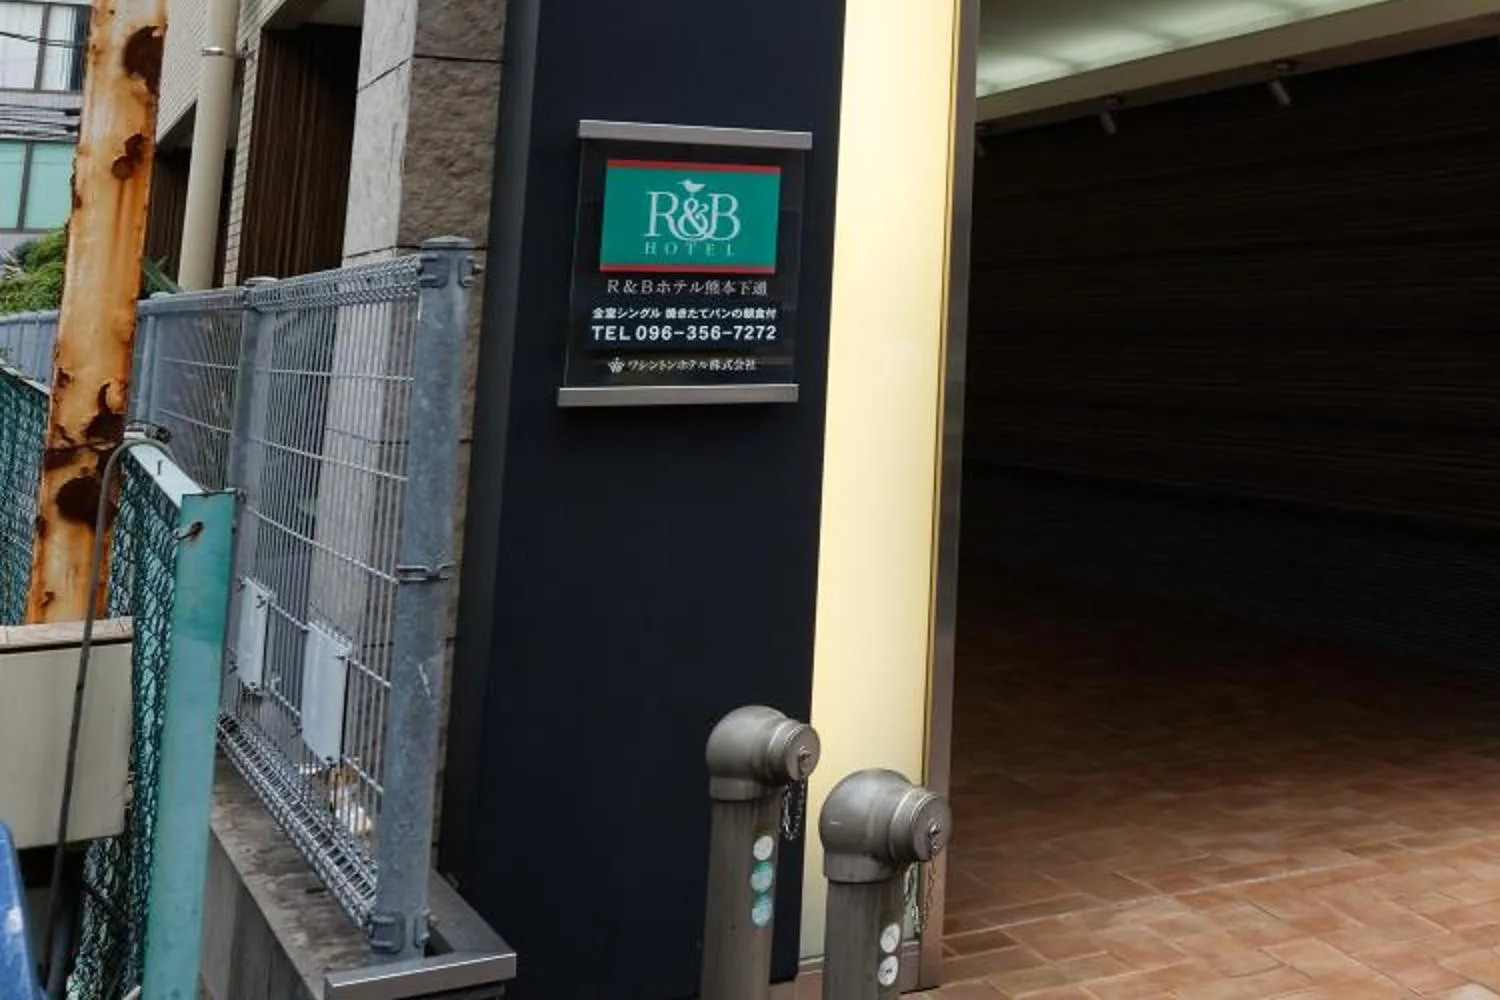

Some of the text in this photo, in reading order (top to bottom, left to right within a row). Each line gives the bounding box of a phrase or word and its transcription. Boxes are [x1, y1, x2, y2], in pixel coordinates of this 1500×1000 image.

[641, 191, 741, 241] R&B
[644, 241, 737, 257] HOTEL
[592, 325, 777, 342] TEL 096-356-7272
